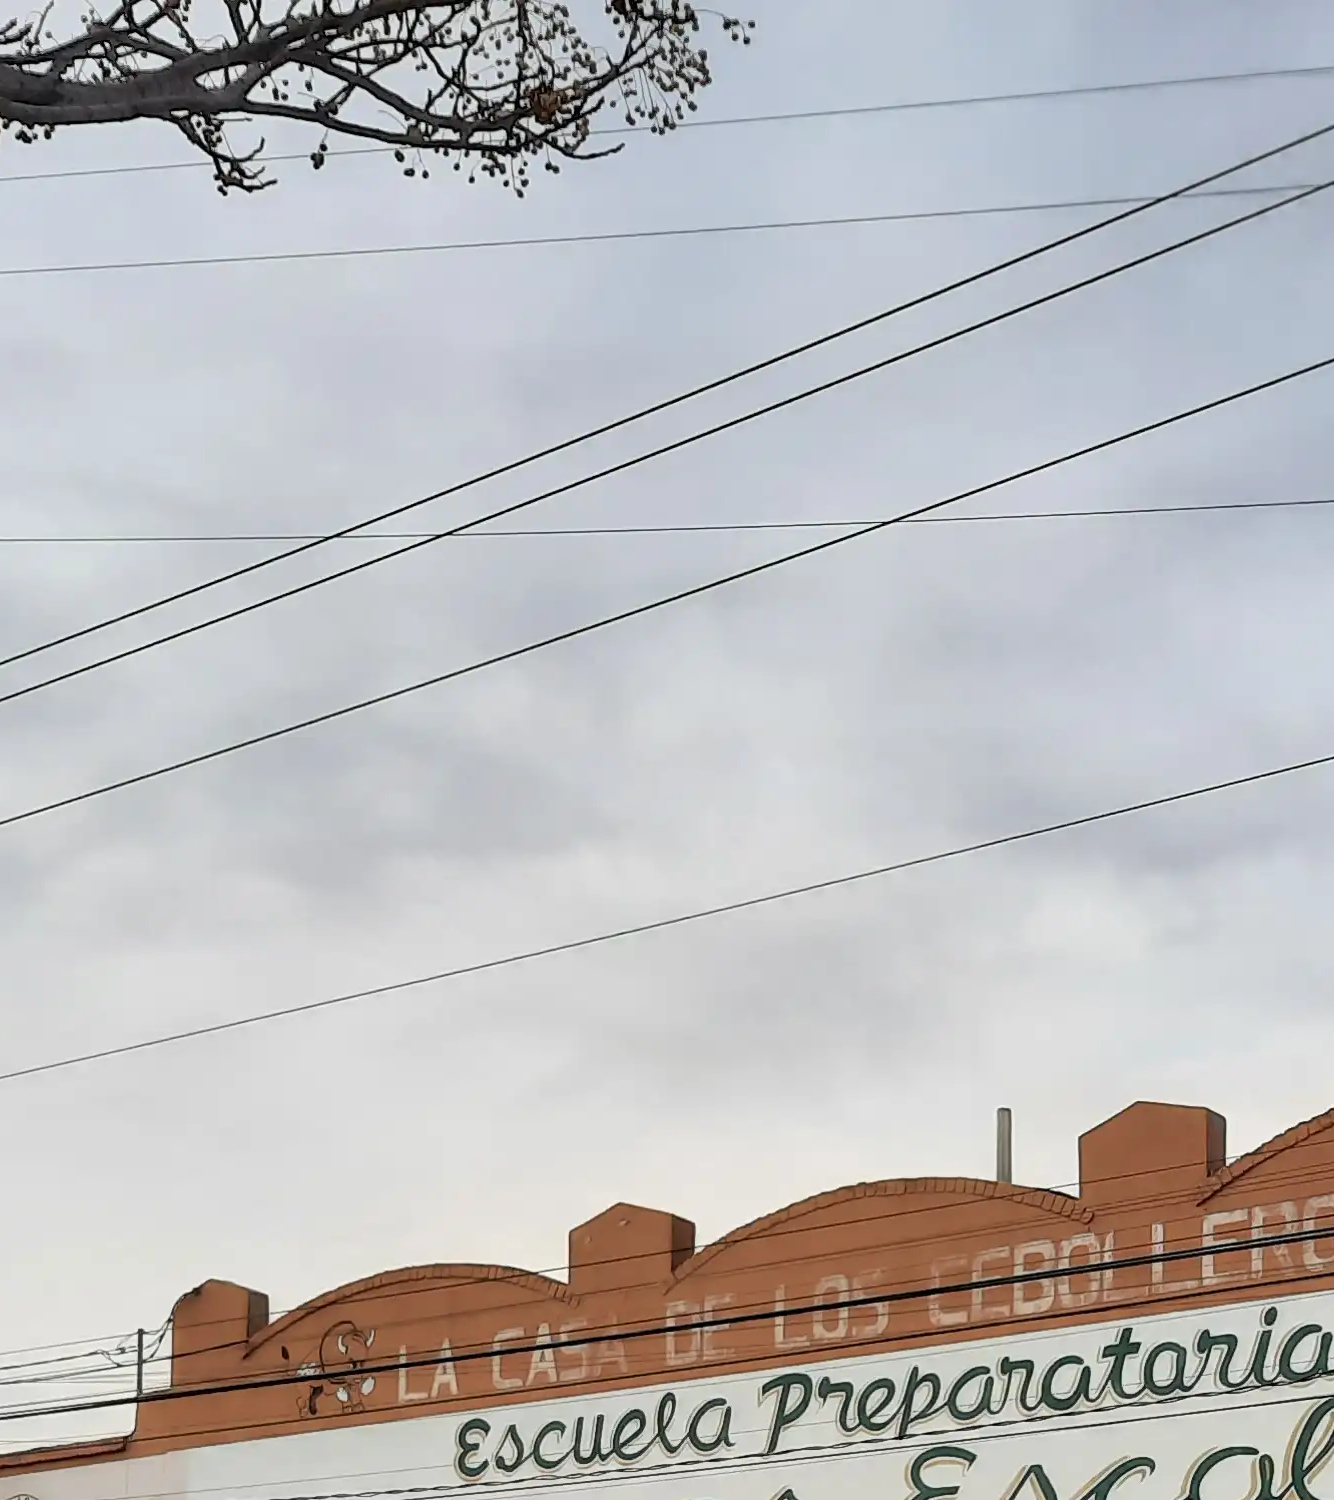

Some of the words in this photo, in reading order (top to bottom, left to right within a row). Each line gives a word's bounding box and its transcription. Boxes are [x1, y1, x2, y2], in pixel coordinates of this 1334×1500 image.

[398, 1337, 459, 1404] LA
[492, 1314, 629, 1390] CASA
[664, 1292, 737, 1366] DE
[774, 1267, 890, 1348] LOS
[455, 1391, 736, 1480] Escuela
